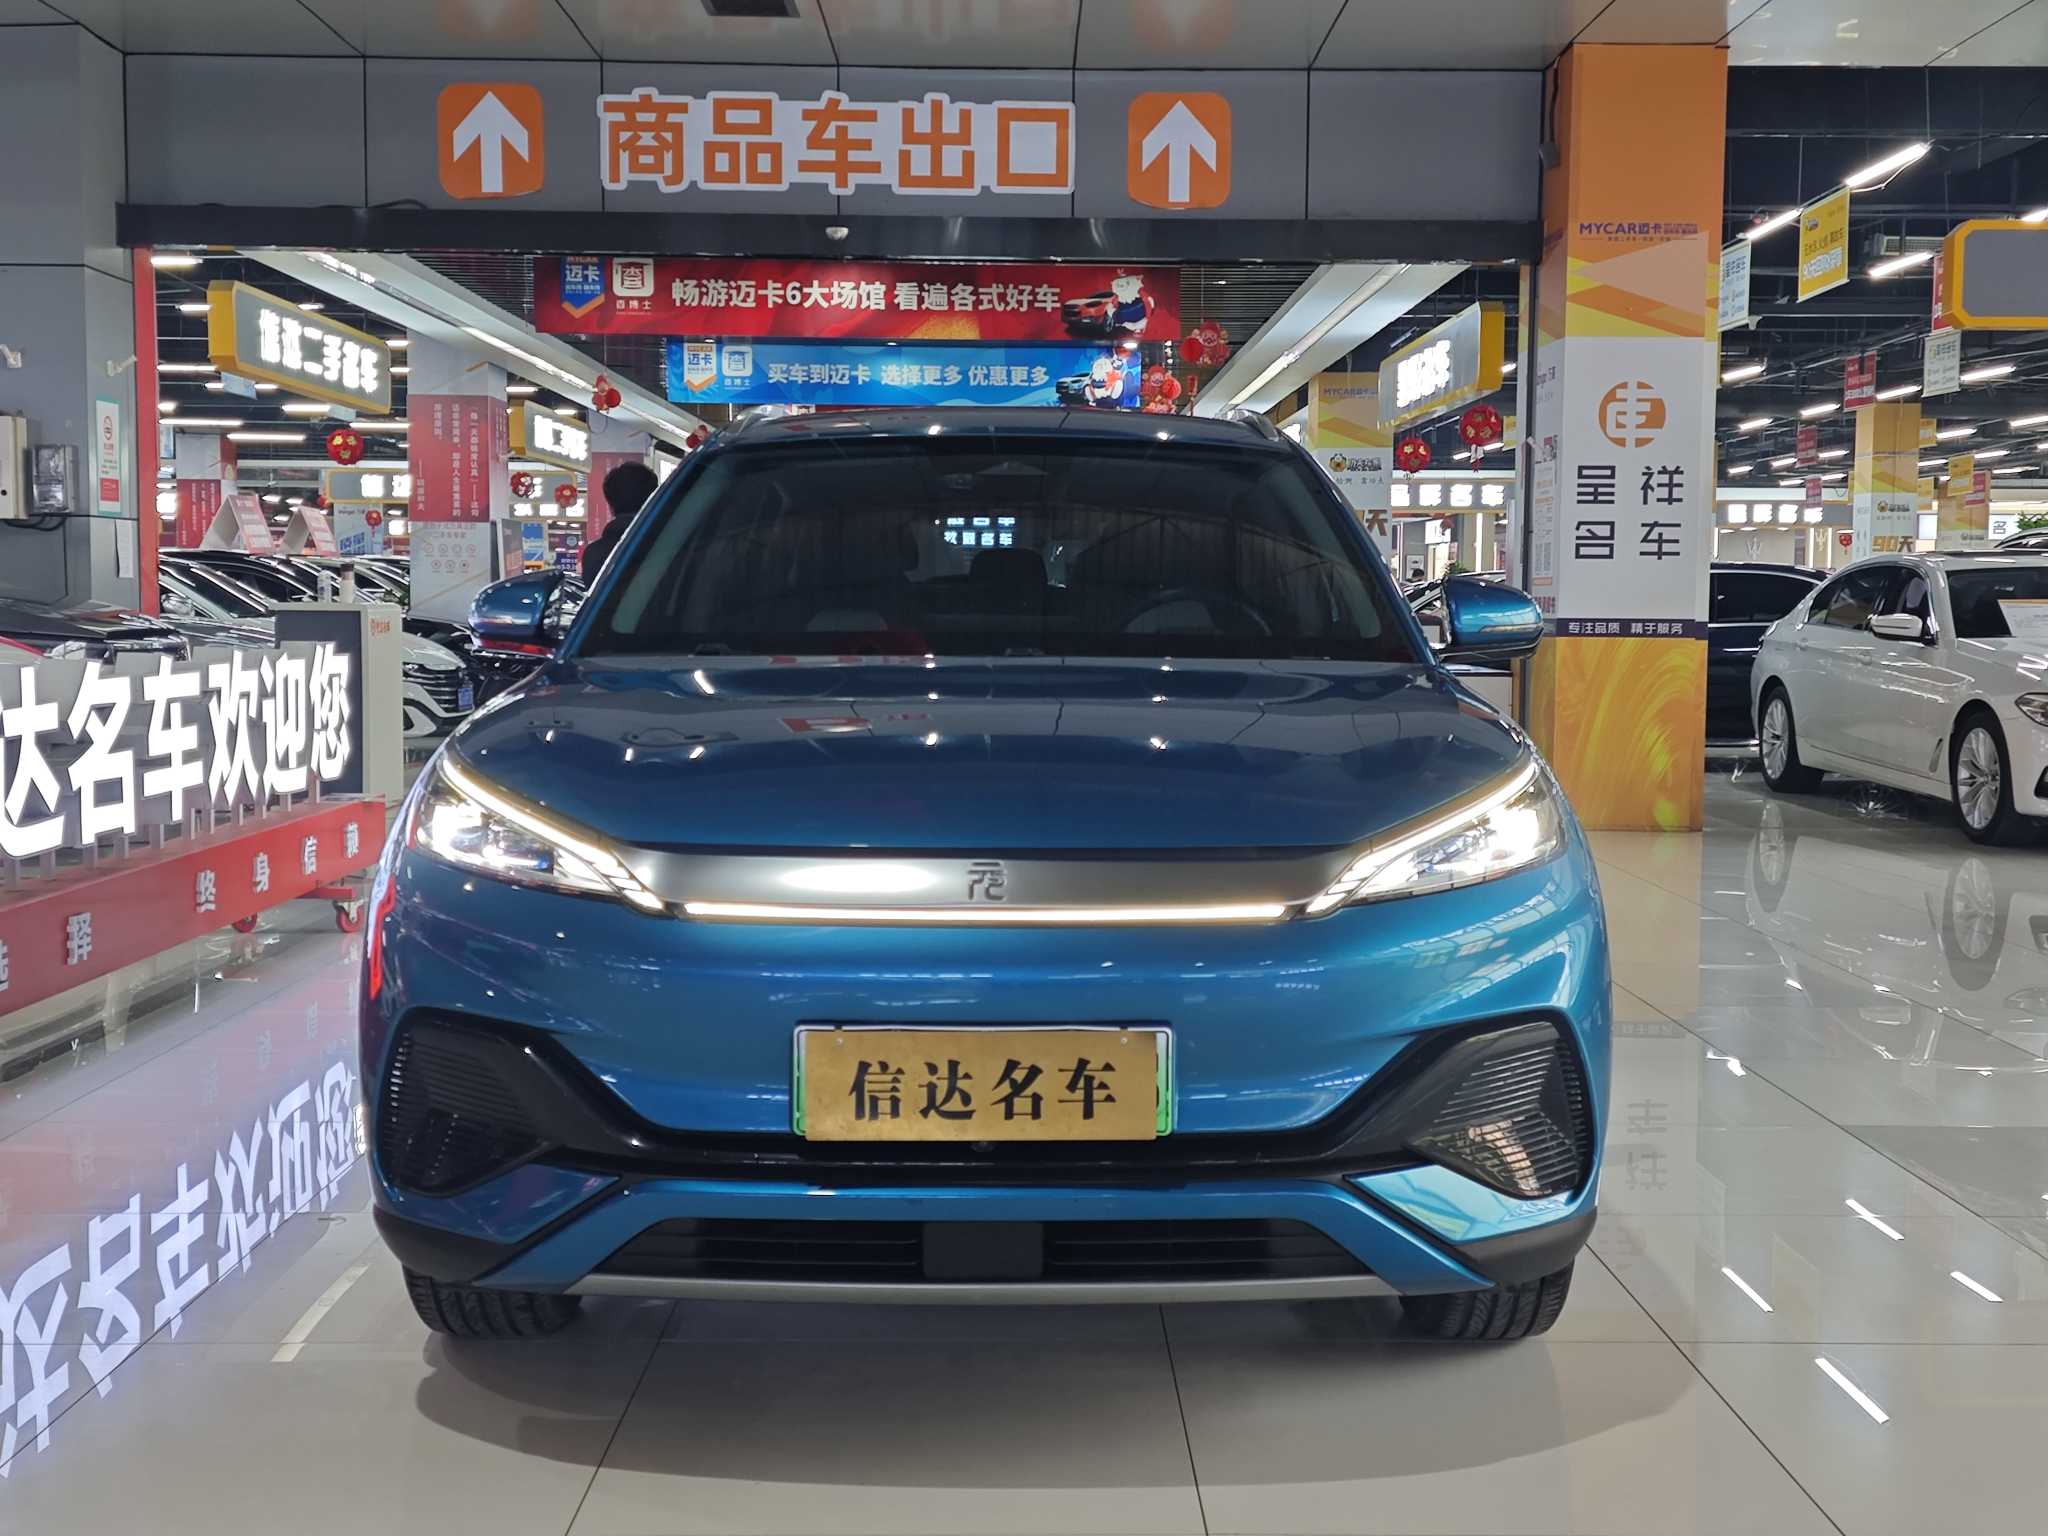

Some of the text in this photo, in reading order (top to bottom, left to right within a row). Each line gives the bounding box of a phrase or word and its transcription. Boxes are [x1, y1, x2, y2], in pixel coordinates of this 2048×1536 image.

[602, 94, 1071, 192] 商品车出口
[565, 264, 601, 283] 迈卡
[671, 277, 1061, 313] 畅游迈卡6大场馆 看遍各式好车
[768, 363, 1050, 387] 买车到迈卡 选择更多 优惠更多
[1577, 465, 1684, 505] 呈祥
[1575, 520, 1682, 560] 名车
[1568, 622, 1683, 634] 专注品质 精于服务
[0, 642, 353, 858] 达名车欢迎您
[848, 1056, 1117, 1122] 信达名车
